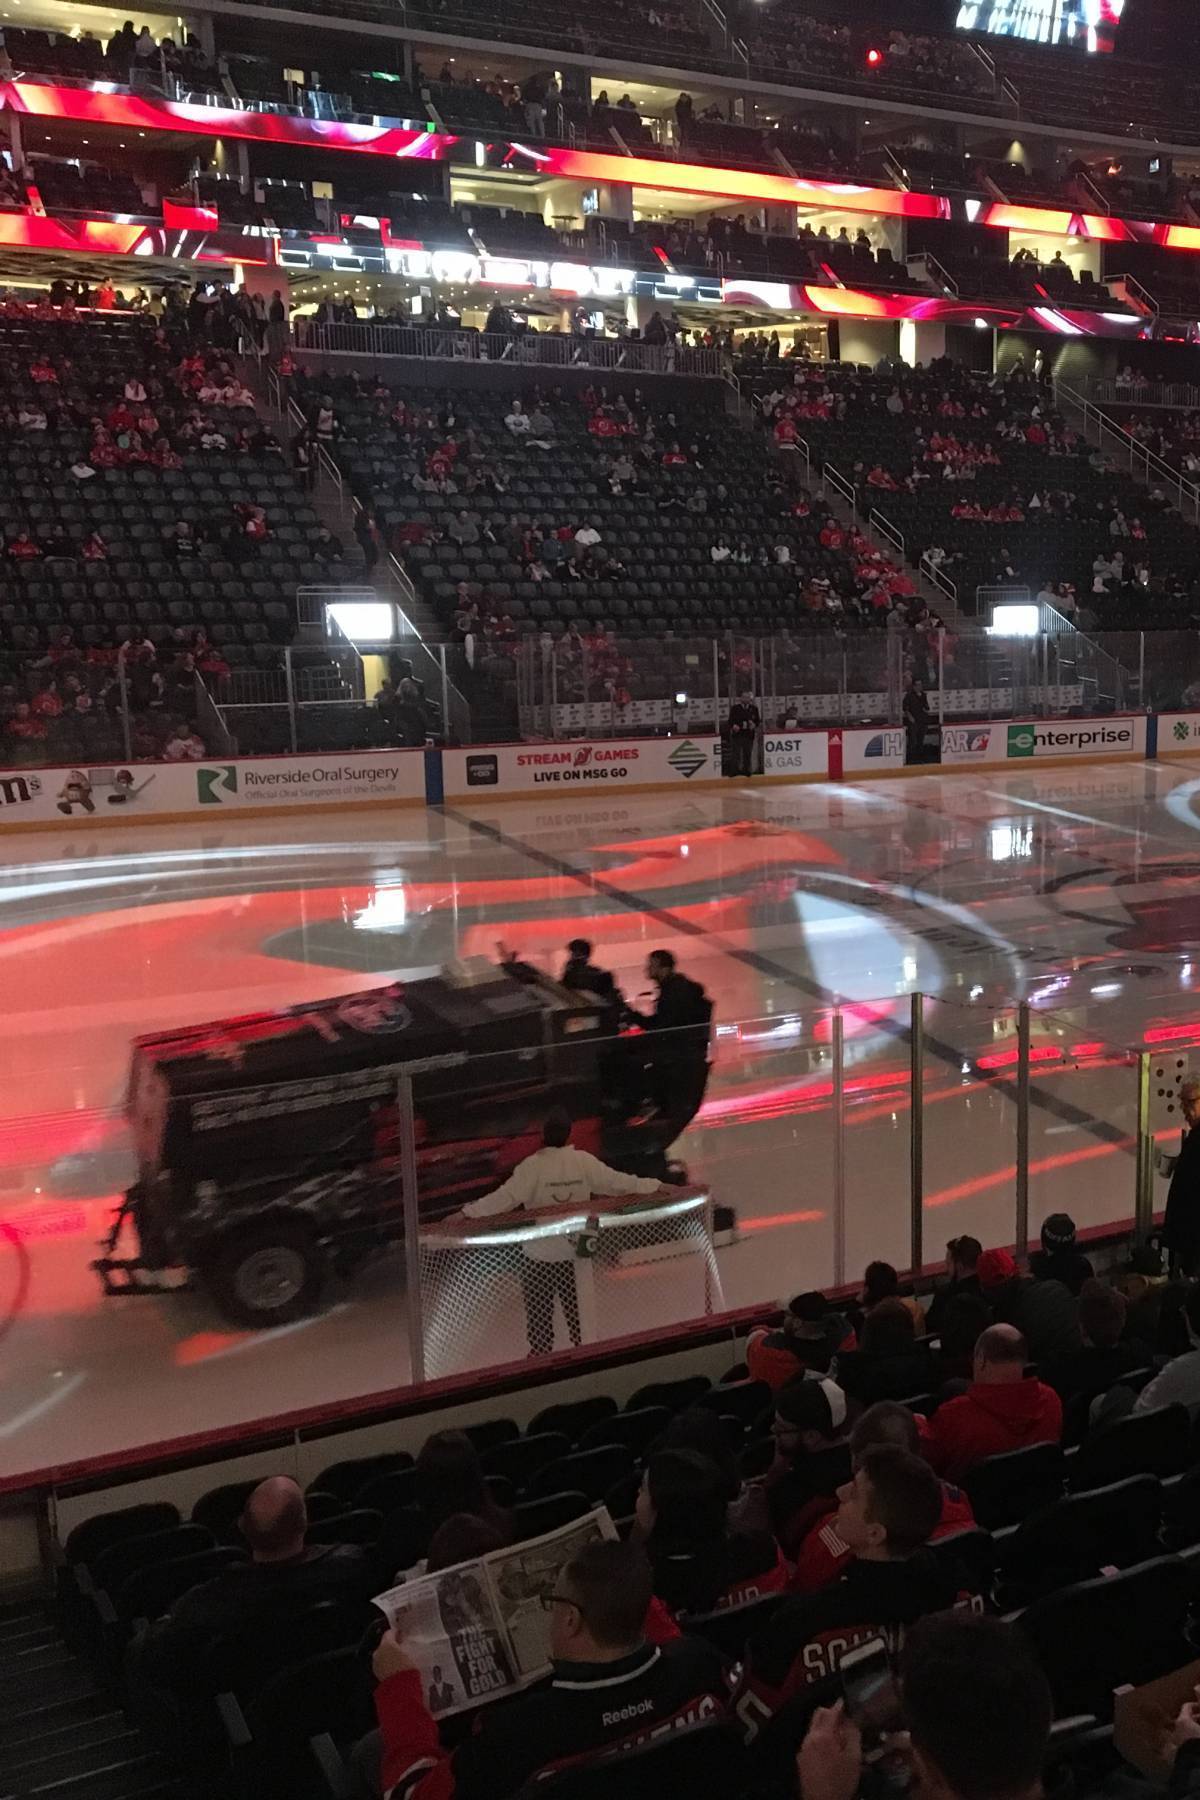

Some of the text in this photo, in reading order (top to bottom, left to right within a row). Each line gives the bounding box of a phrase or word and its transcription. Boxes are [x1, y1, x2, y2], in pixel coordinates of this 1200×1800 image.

[765, 740, 802, 753] OAST
[1016, 727, 1131, 748] enterprise
[517, 753, 572, 766] STREAM
[594, 749, 639, 761] GAMES
[776, 756, 803, 768] GAS
[244, 767, 399, 786] Riverside Oral Surgery
[534, 767, 628, 783] LIVE ON MSG GO
[244, 790, 277, 799] Official
[279, 789, 298, 798] Oral
[354, 785, 369, 793] the
[455, 1637, 497, 1662] FIGHT
[468, 1655, 495, 1677] FOR
[469, 1670, 507, 1695] GOLD
[601, 1698, 654, 1727] Reebok
